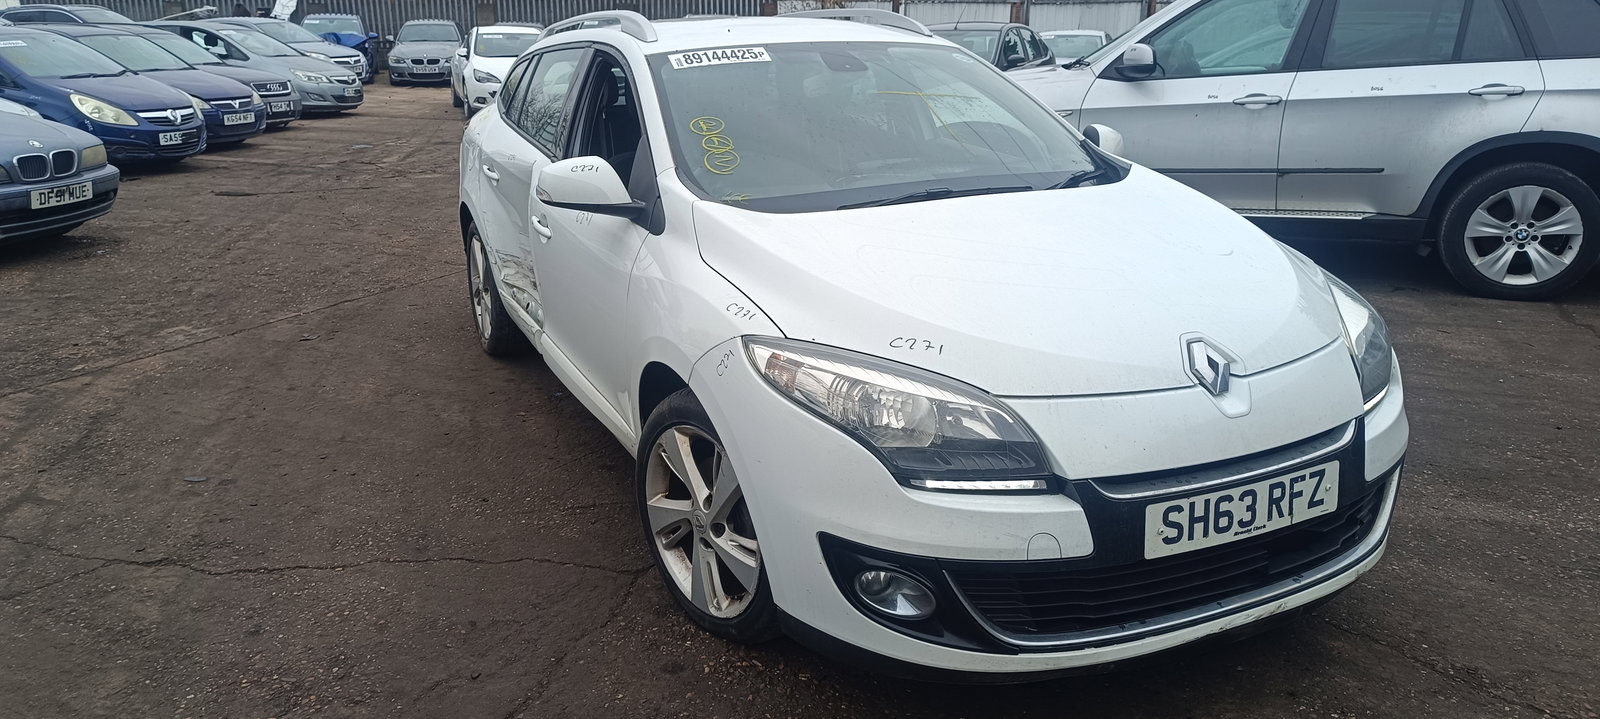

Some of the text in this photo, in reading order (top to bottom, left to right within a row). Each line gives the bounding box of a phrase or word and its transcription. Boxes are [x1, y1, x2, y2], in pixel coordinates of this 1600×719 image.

[570, 164, 600, 173] C271
[726, 302, 756, 321] C271
[889, 337, 944, 356] C271
[1161, 467, 1327, 546] SH63 RFZ
